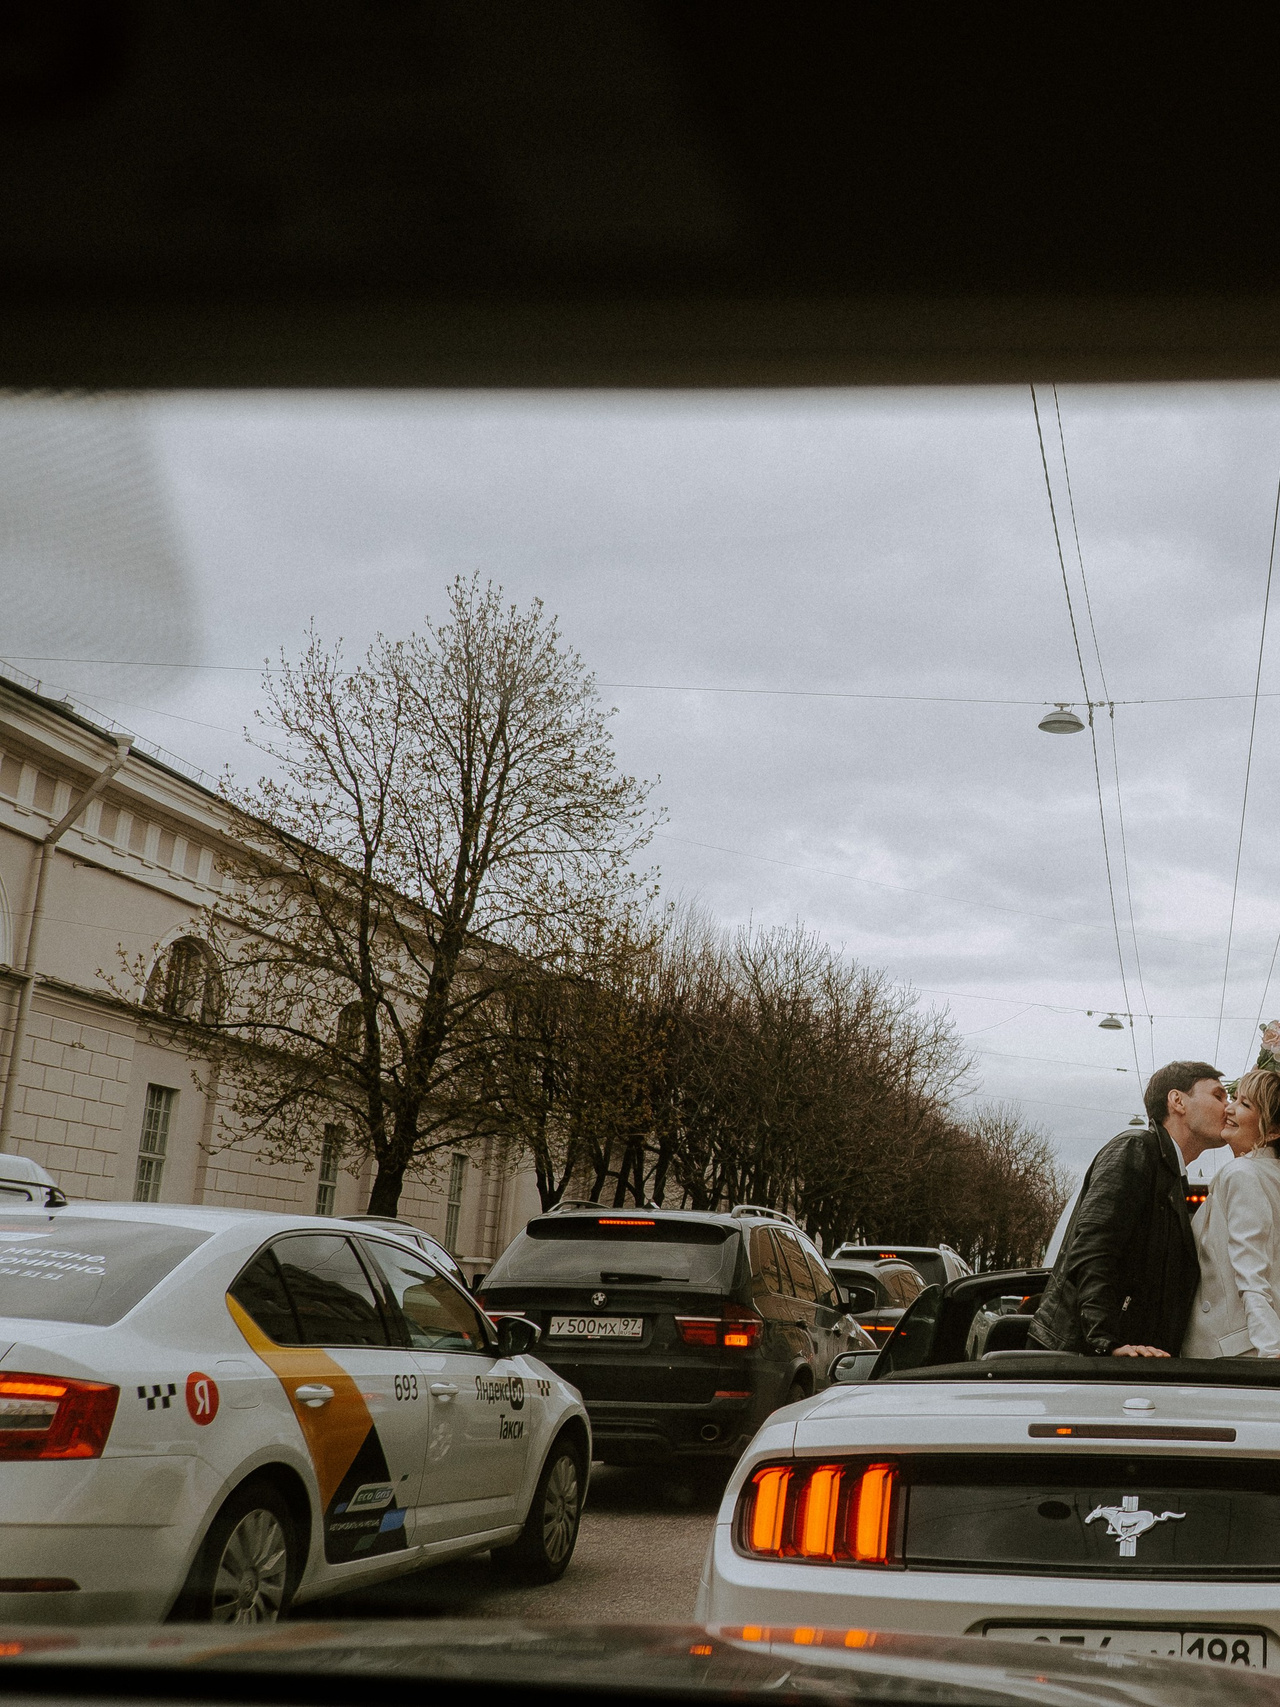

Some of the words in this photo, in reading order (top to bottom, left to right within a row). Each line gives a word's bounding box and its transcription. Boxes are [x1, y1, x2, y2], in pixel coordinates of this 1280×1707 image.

[622, 1319, 638, 1330] 97
[194, 1380, 210, 1415] Я
[394, 1374, 418, 1401] 693
[475, 1376, 511, 1404] Яндекс
[499, 1414, 524, 1440] Такси
[1187, 1638, 1250, 1667] 198
